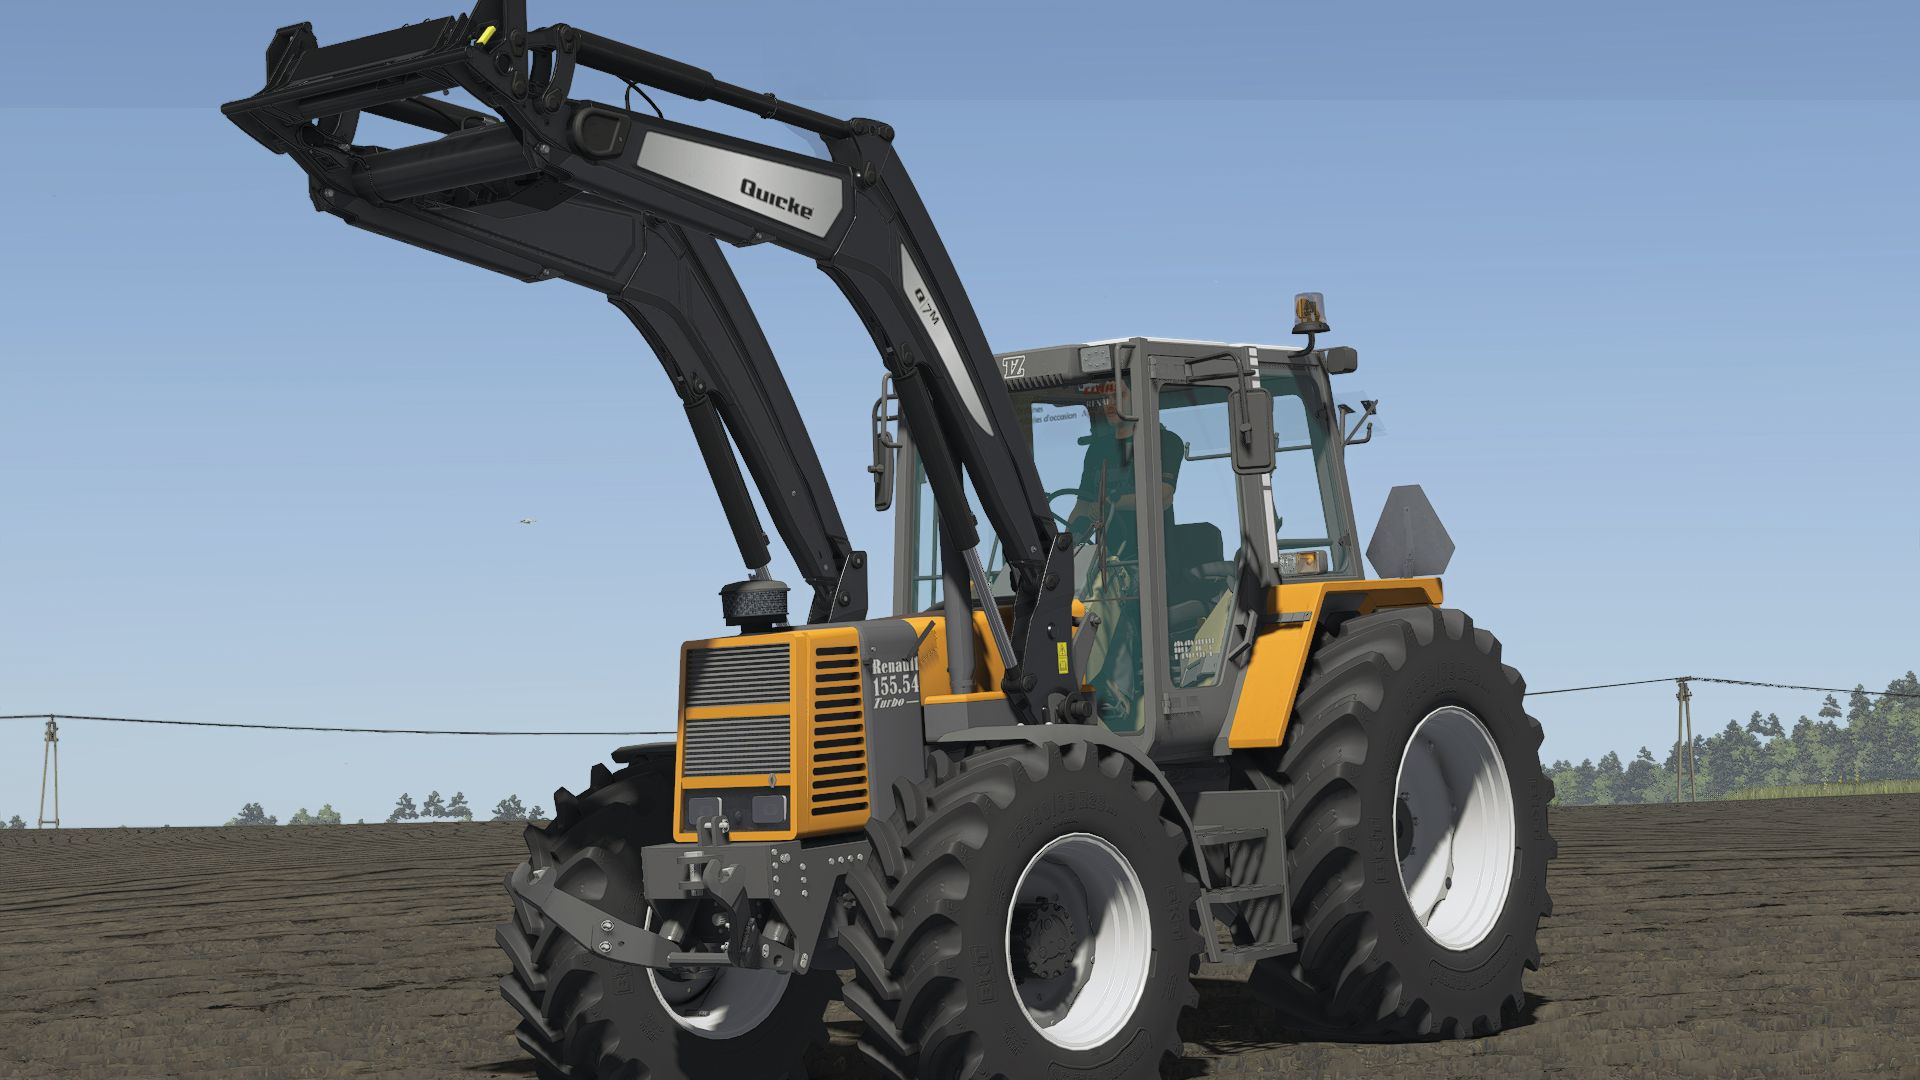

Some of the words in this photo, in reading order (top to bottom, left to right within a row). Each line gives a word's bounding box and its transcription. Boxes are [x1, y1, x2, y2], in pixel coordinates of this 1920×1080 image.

[740, 178, 814, 220] Quicke
[872, 656, 919, 675] Renault
[873, 674, 919, 696] 155.54
[873, 697, 904, 709] Turbo
